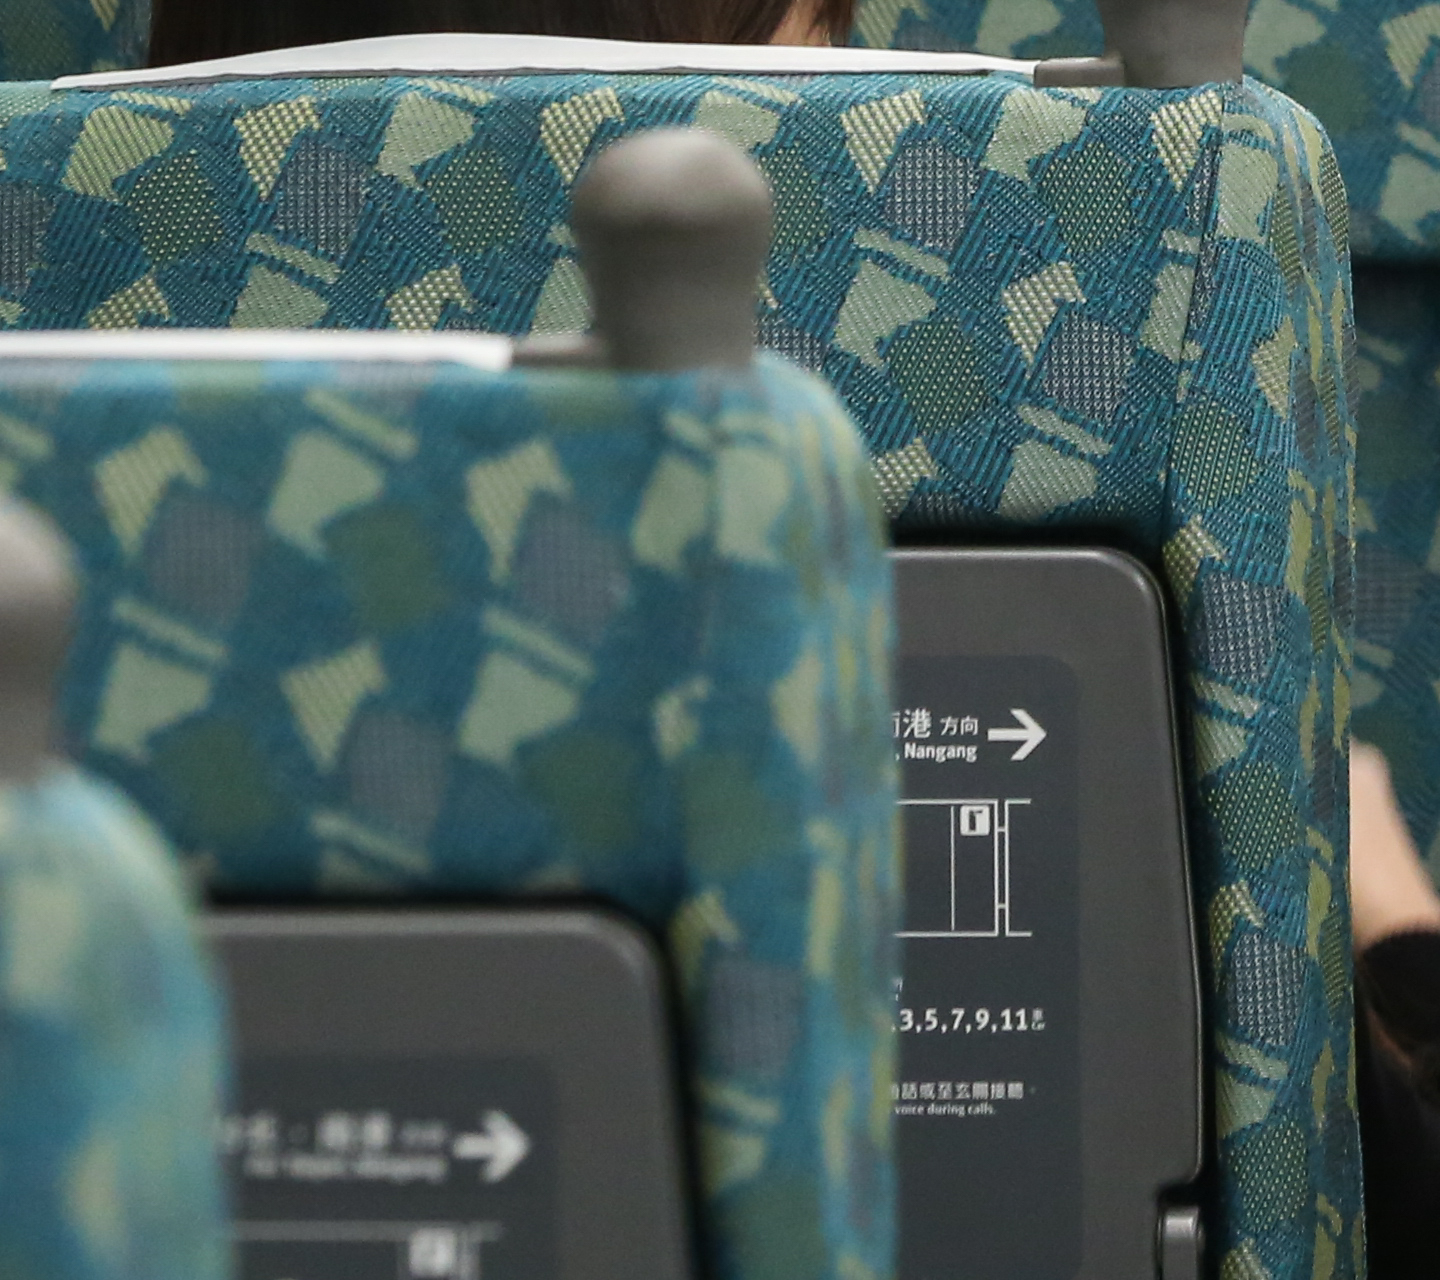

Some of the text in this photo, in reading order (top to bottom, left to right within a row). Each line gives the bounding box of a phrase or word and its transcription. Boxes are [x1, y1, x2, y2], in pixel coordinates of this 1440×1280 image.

[940, 715, 978, 736] 方向
[904, 742, 978, 763] Nangang
[927, 1102, 966, 1117] during
